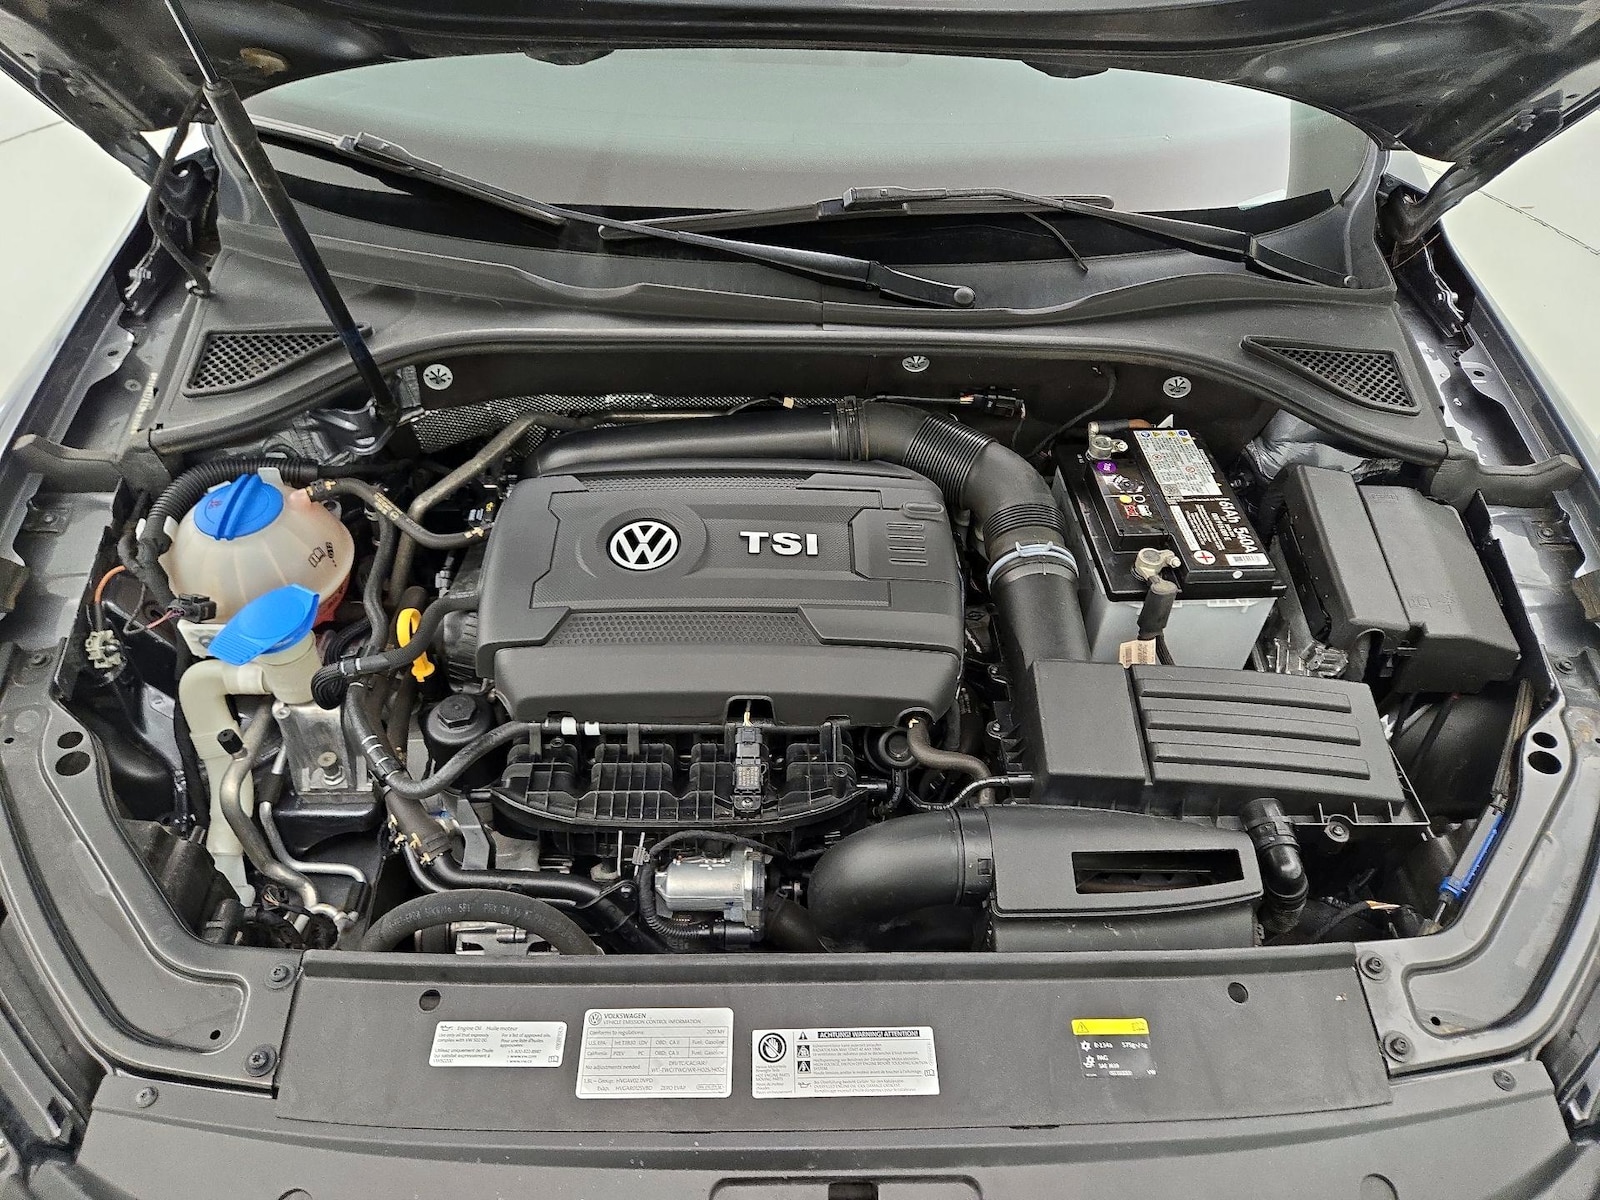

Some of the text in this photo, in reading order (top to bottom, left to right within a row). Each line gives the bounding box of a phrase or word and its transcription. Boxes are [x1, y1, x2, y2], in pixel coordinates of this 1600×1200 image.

[740, 531, 819, 556] TSI
[1219, 501, 1241, 524] 61Ah
[1234, 527, 1258, 553] 540A
